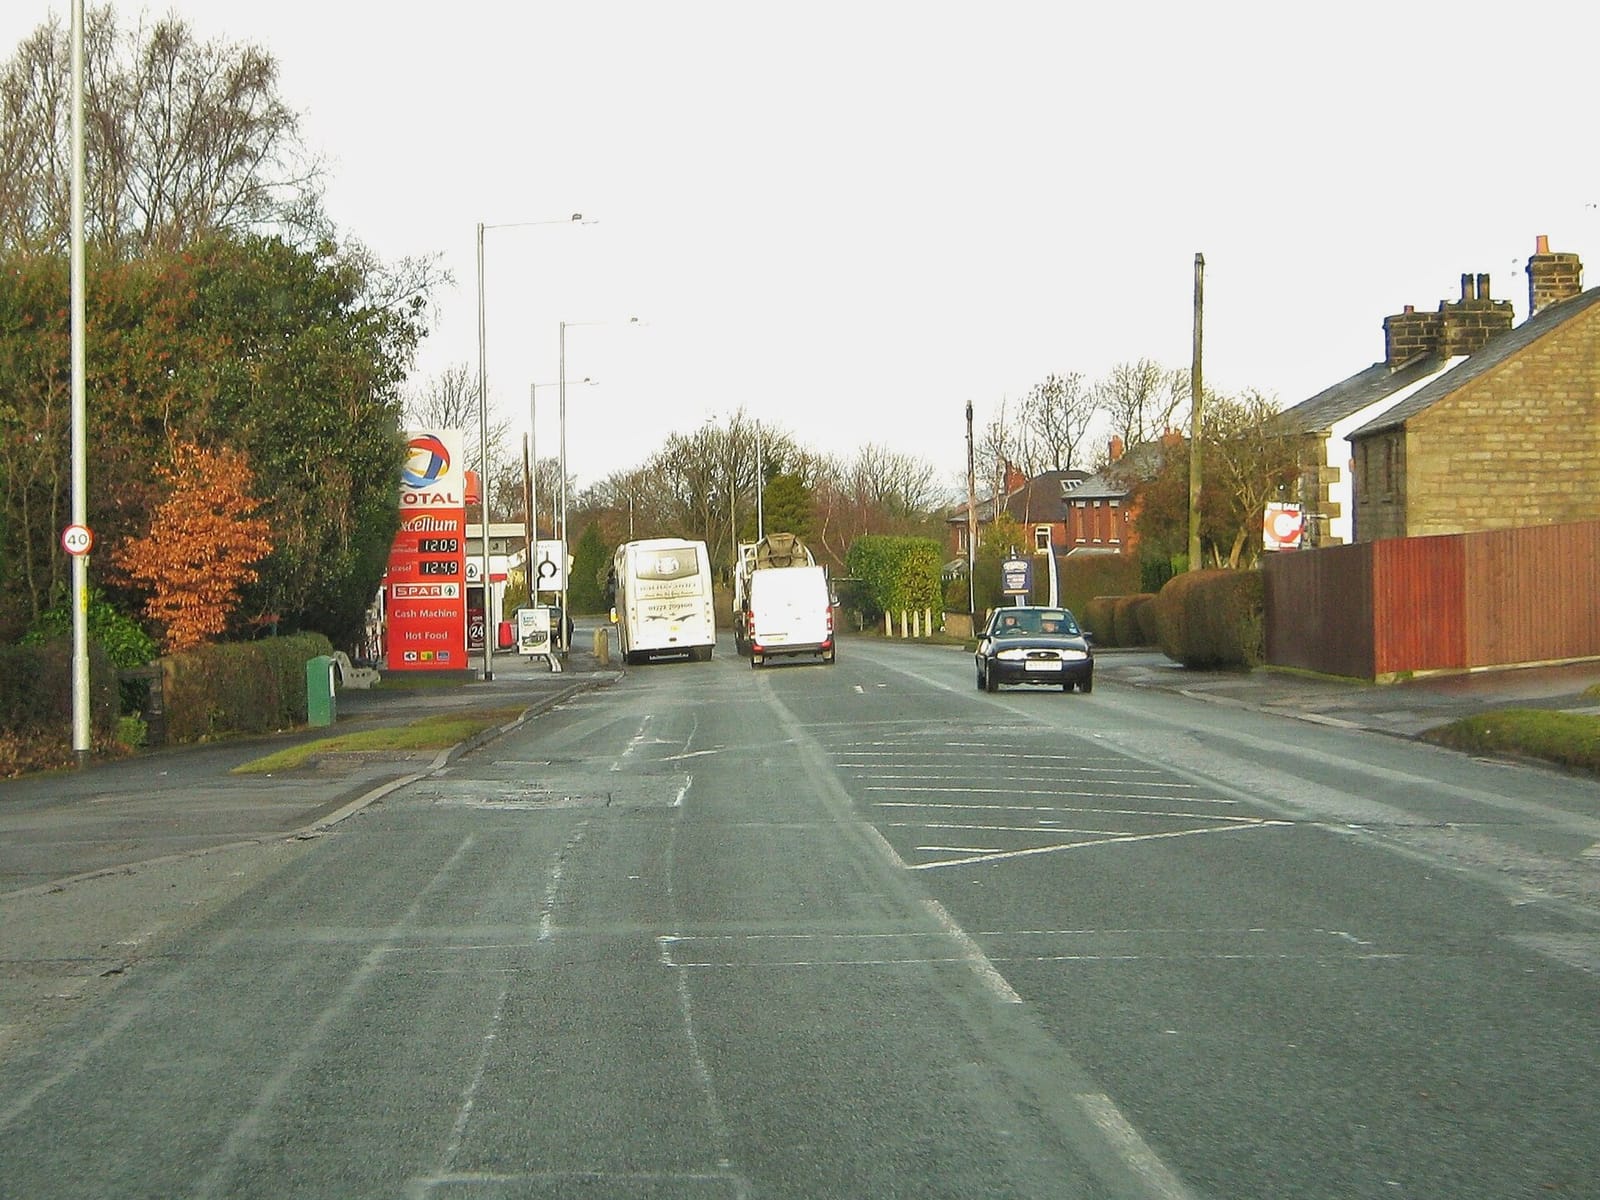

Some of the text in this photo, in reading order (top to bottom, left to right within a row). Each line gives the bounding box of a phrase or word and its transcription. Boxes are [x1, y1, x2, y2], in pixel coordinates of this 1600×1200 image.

[400, 491, 459, 504] OTAL
[401, 516, 458, 532] xcellium
[67, 534, 88, 545] 40
[397, 587, 440, 596] SPAR
[395, 609, 457, 618] Cash Machine
[405, 631, 448, 640] Hot Food
[471, 626, 484, 639] 24
